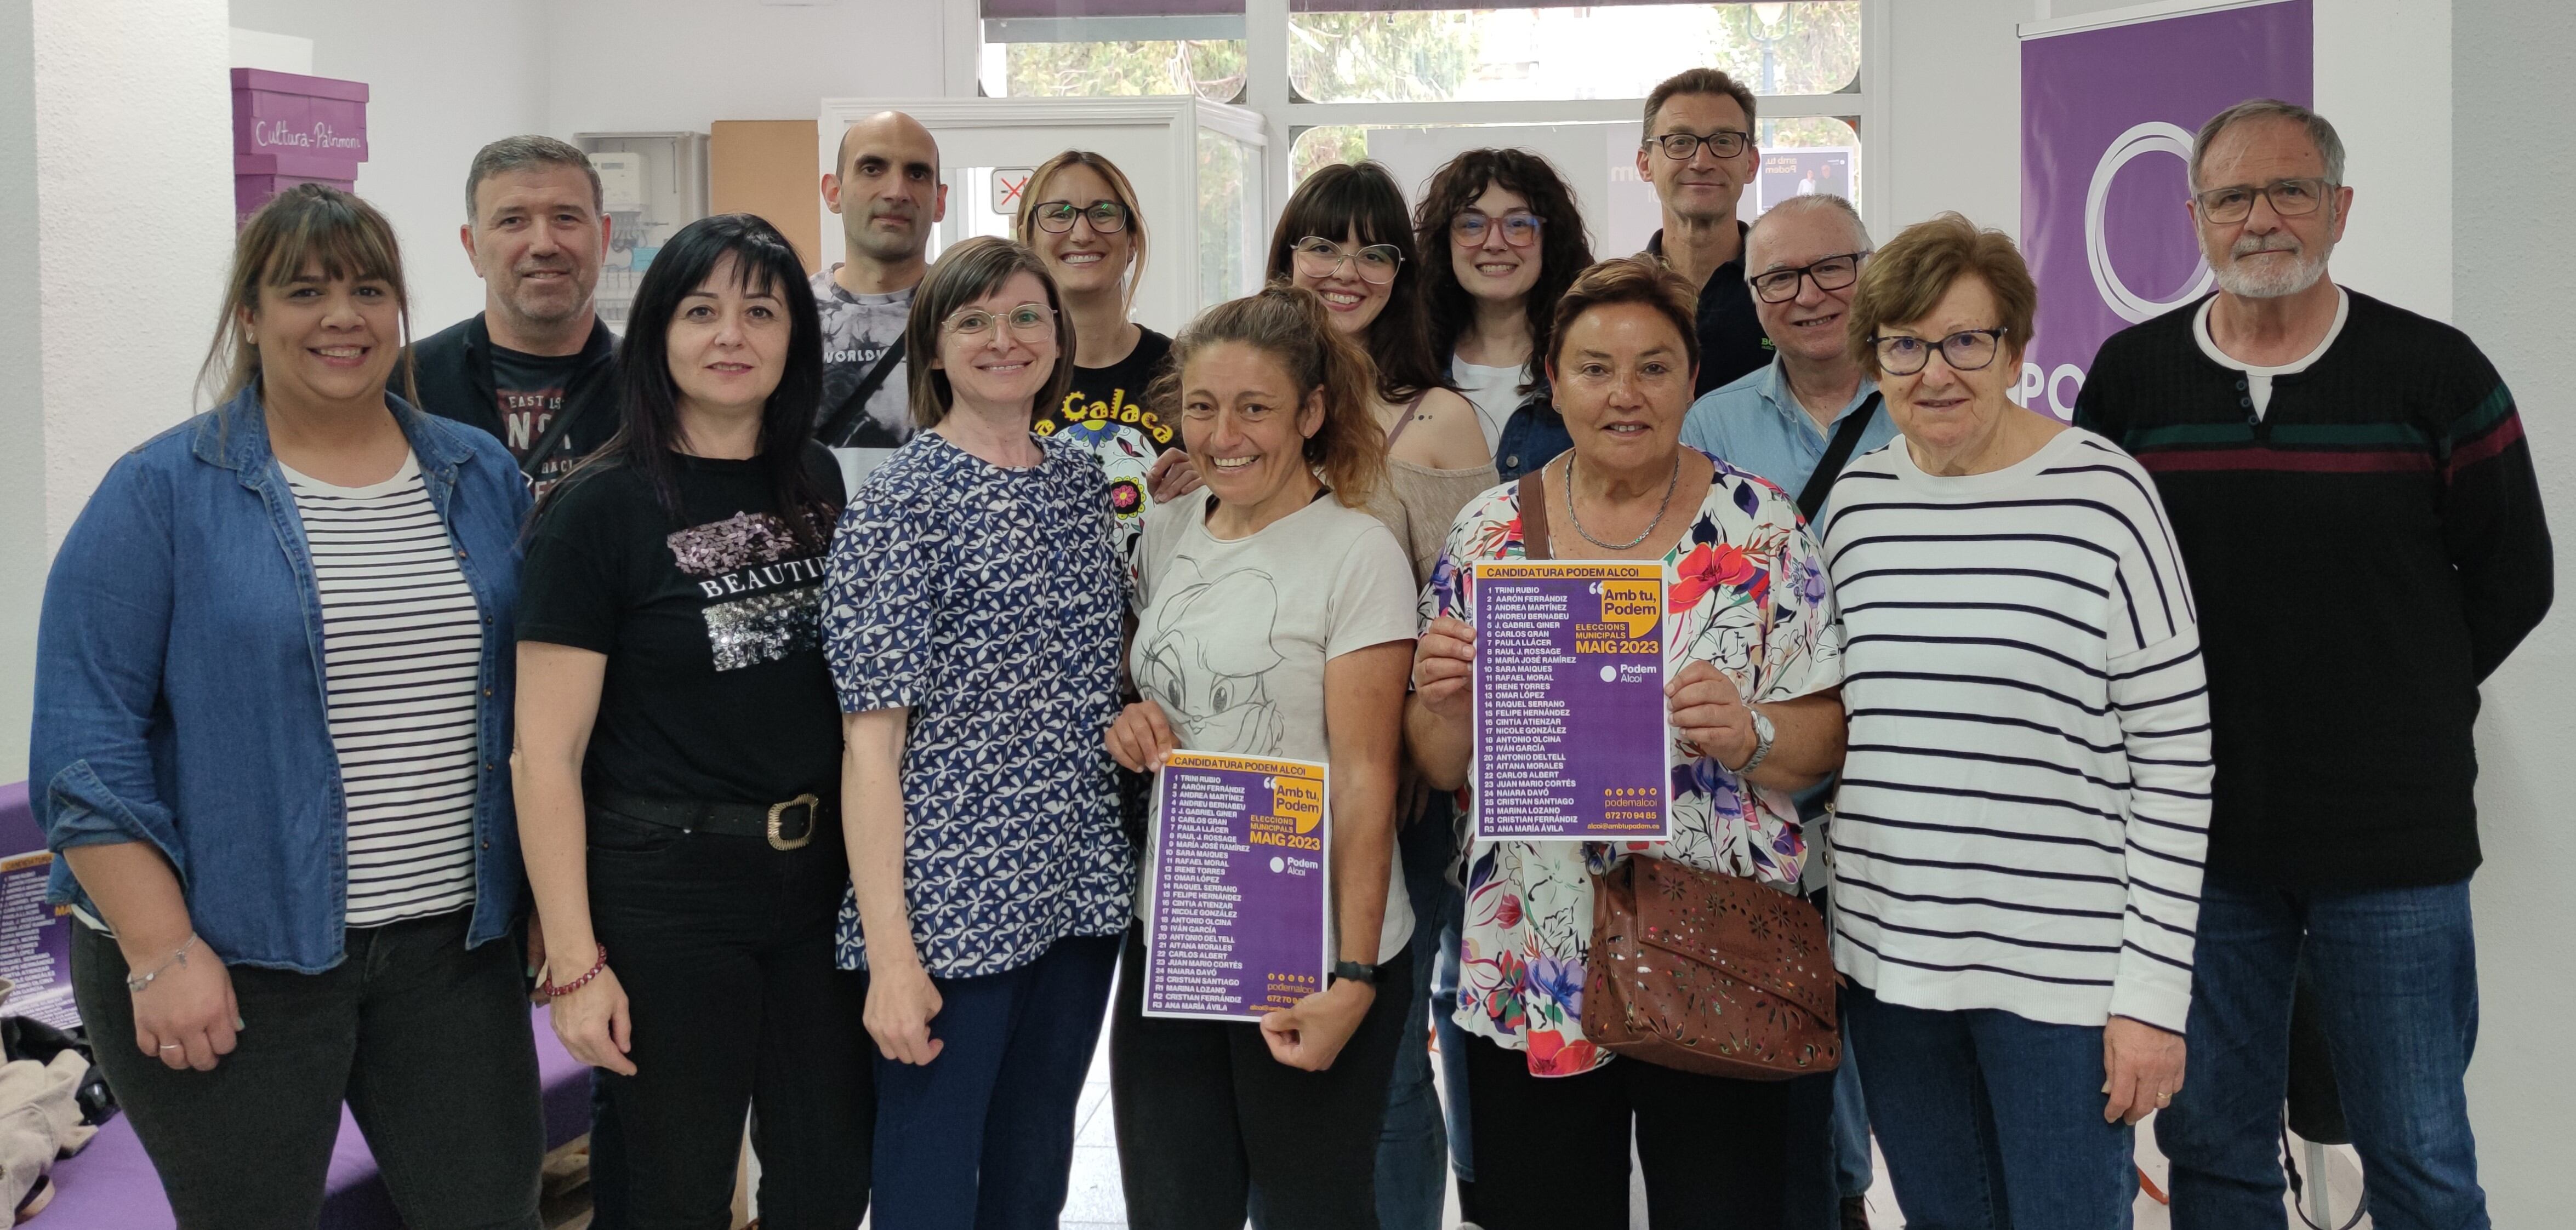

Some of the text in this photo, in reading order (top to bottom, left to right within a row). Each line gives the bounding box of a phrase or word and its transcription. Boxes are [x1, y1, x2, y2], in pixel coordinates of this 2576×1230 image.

[509, 396, 544, 408] EAST
[1061, 388, 1173, 444] Calaca
[1487, 568, 1638, 577] CANDIDATURA PODEM ALCOI
[1496, 594, 1523, 602] AARÓN
[1524, 594, 1568, 602] FERRÁNDIZ
[1604, 590, 1656, 602] Amb tu,
[1528, 603, 1566, 611] MARTÍNEZ
[1605, 603, 1656, 615] Podem
[1521, 638, 1551, 646] LLÁCER
[1576, 640, 1659, 654] MAIG 2023
[1495, 655, 1520, 663] MARÍA
[1521, 655, 1541, 663] JOSÉ
[1542, 655, 1576, 663] RAMÍREZ
[1621, 664, 1656, 673] Podem
[1621, 674, 1642, 683] Alcoi
[1519, 690, 1545, 699] LÓPEZ
[1523, 708, 1570, 716] HERNÁNDEZ
[1525, 725, 1566, 734] GONZÁLEZ
[1496, 743, 1514, 752] IVÁN
[1515, 743, 1545, 752] GARCÍA
[1174, 756, 1306, 775] CANDIDATURA PODEM ALCOI
[1545, 778, 1576, 787] CORTÉS
[1206, 783, 1245, 793] FERRÁNDIZ
[1527, 787, 1549, 796] DAVÓ
[1209, 792, 1244, 802] MARTÍNEZ
[1276, 786, 1320, 802] Amb tu,
[1275, 798, 1320, 813] Podem
[1605, 798, 1657, 808] podemalcoi
[1250, 815, 1293, 825] ELECCIONS
[1534, 814, 1578, 823] FERRÁNDIZ
[1250, 823, 1294, 832] MUNICIPALS
[1515, 823, 1540, 832] MARÍA
[1541, 823, 1564, 832] ÁVILA
[1250, 832, 1321, 849] MAIG 2023
[1287, 858, 1318, 868] Podem
[1287, 866, 1306, 876] Alcoi
